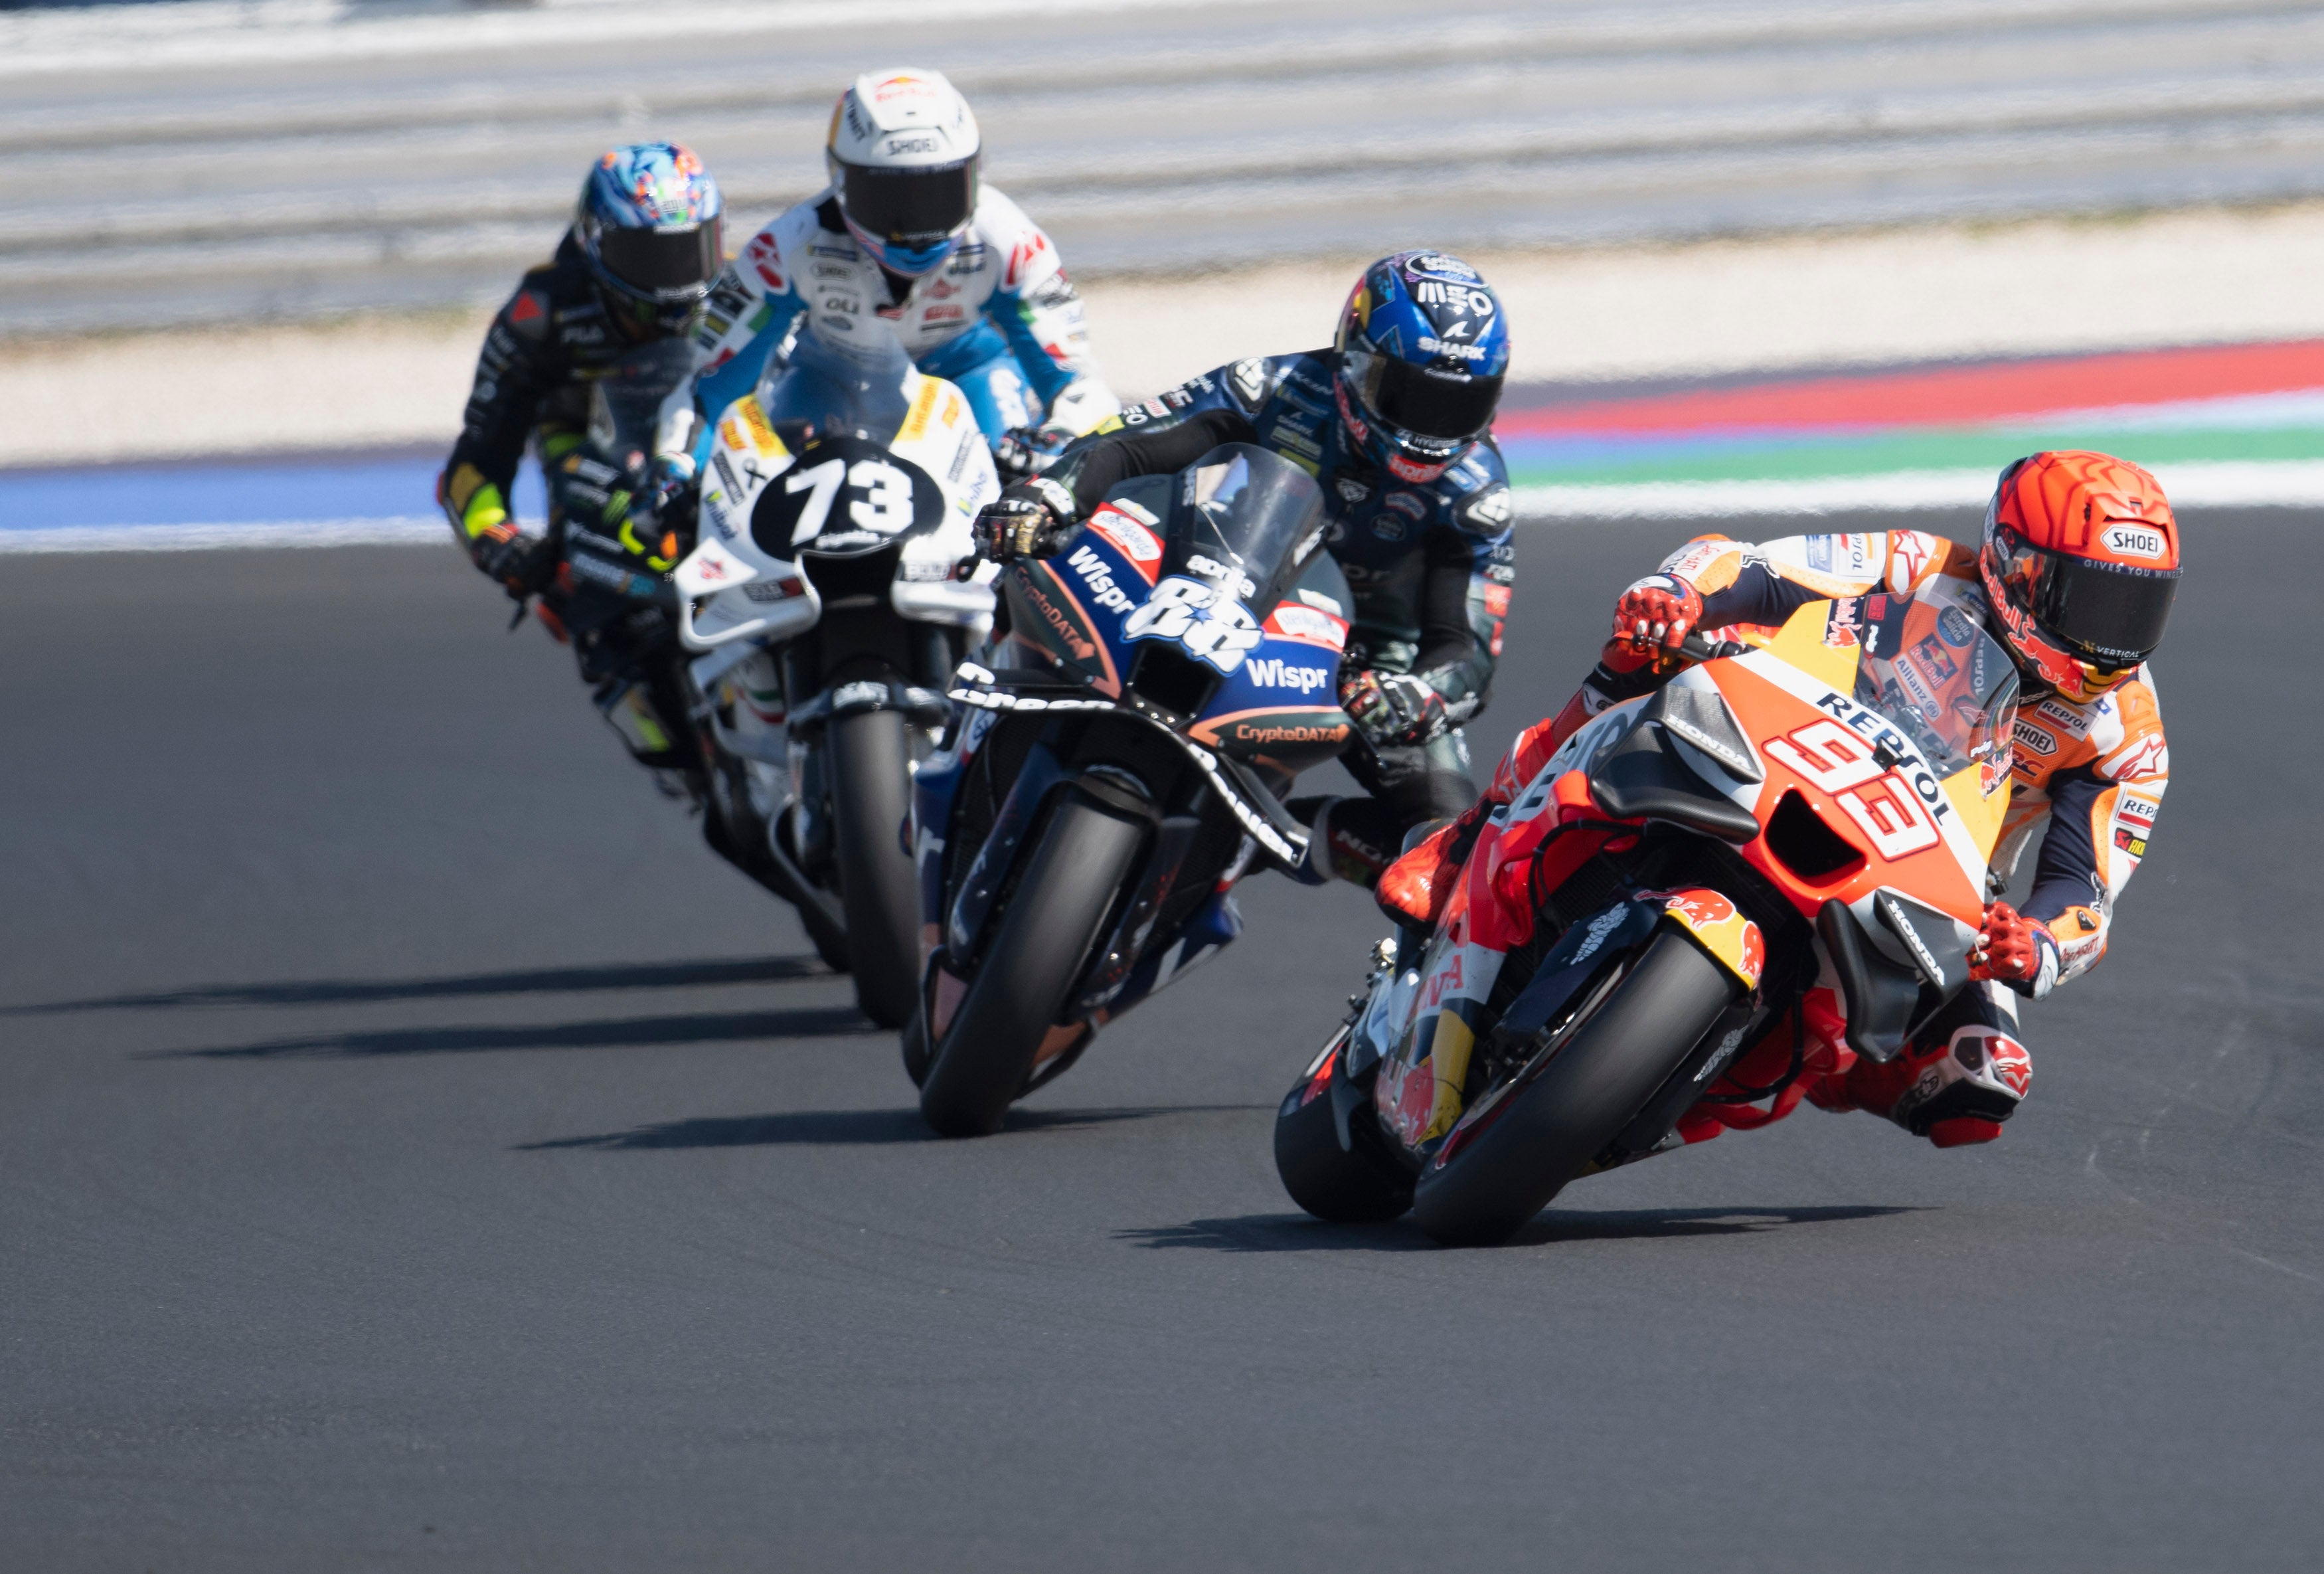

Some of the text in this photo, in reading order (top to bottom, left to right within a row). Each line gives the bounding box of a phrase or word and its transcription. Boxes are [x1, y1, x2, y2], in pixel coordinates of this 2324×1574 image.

[887, 138, 938, 157] SHOEI
[1416, 336, 1487, 361] SHARK
[785, 458, 914, 547] 73
[2114, 531, 2158, 553] SHOEI
[1067, 545, 1136, 615] Wispr
[2084, 559, 2122, 573] GIVES
[2128, 566, 2151, 577] YOU
[2097, 646, 2140, 659] VERTICAL
[1245, 658, 1329, 695] Wispr
[1897, 659, 1928, 702] Allianz
[2042, 701, 2090, 731] REPSOL
[1667, 713, 1752, 770] HONDA
[2013, 722, 2051, 751] SHOEI
[1816, 692, 1950, 827] REPSOL
[1762, 718, 1940, 864] 93
[1888, 899, 1945, 986] HONDA
